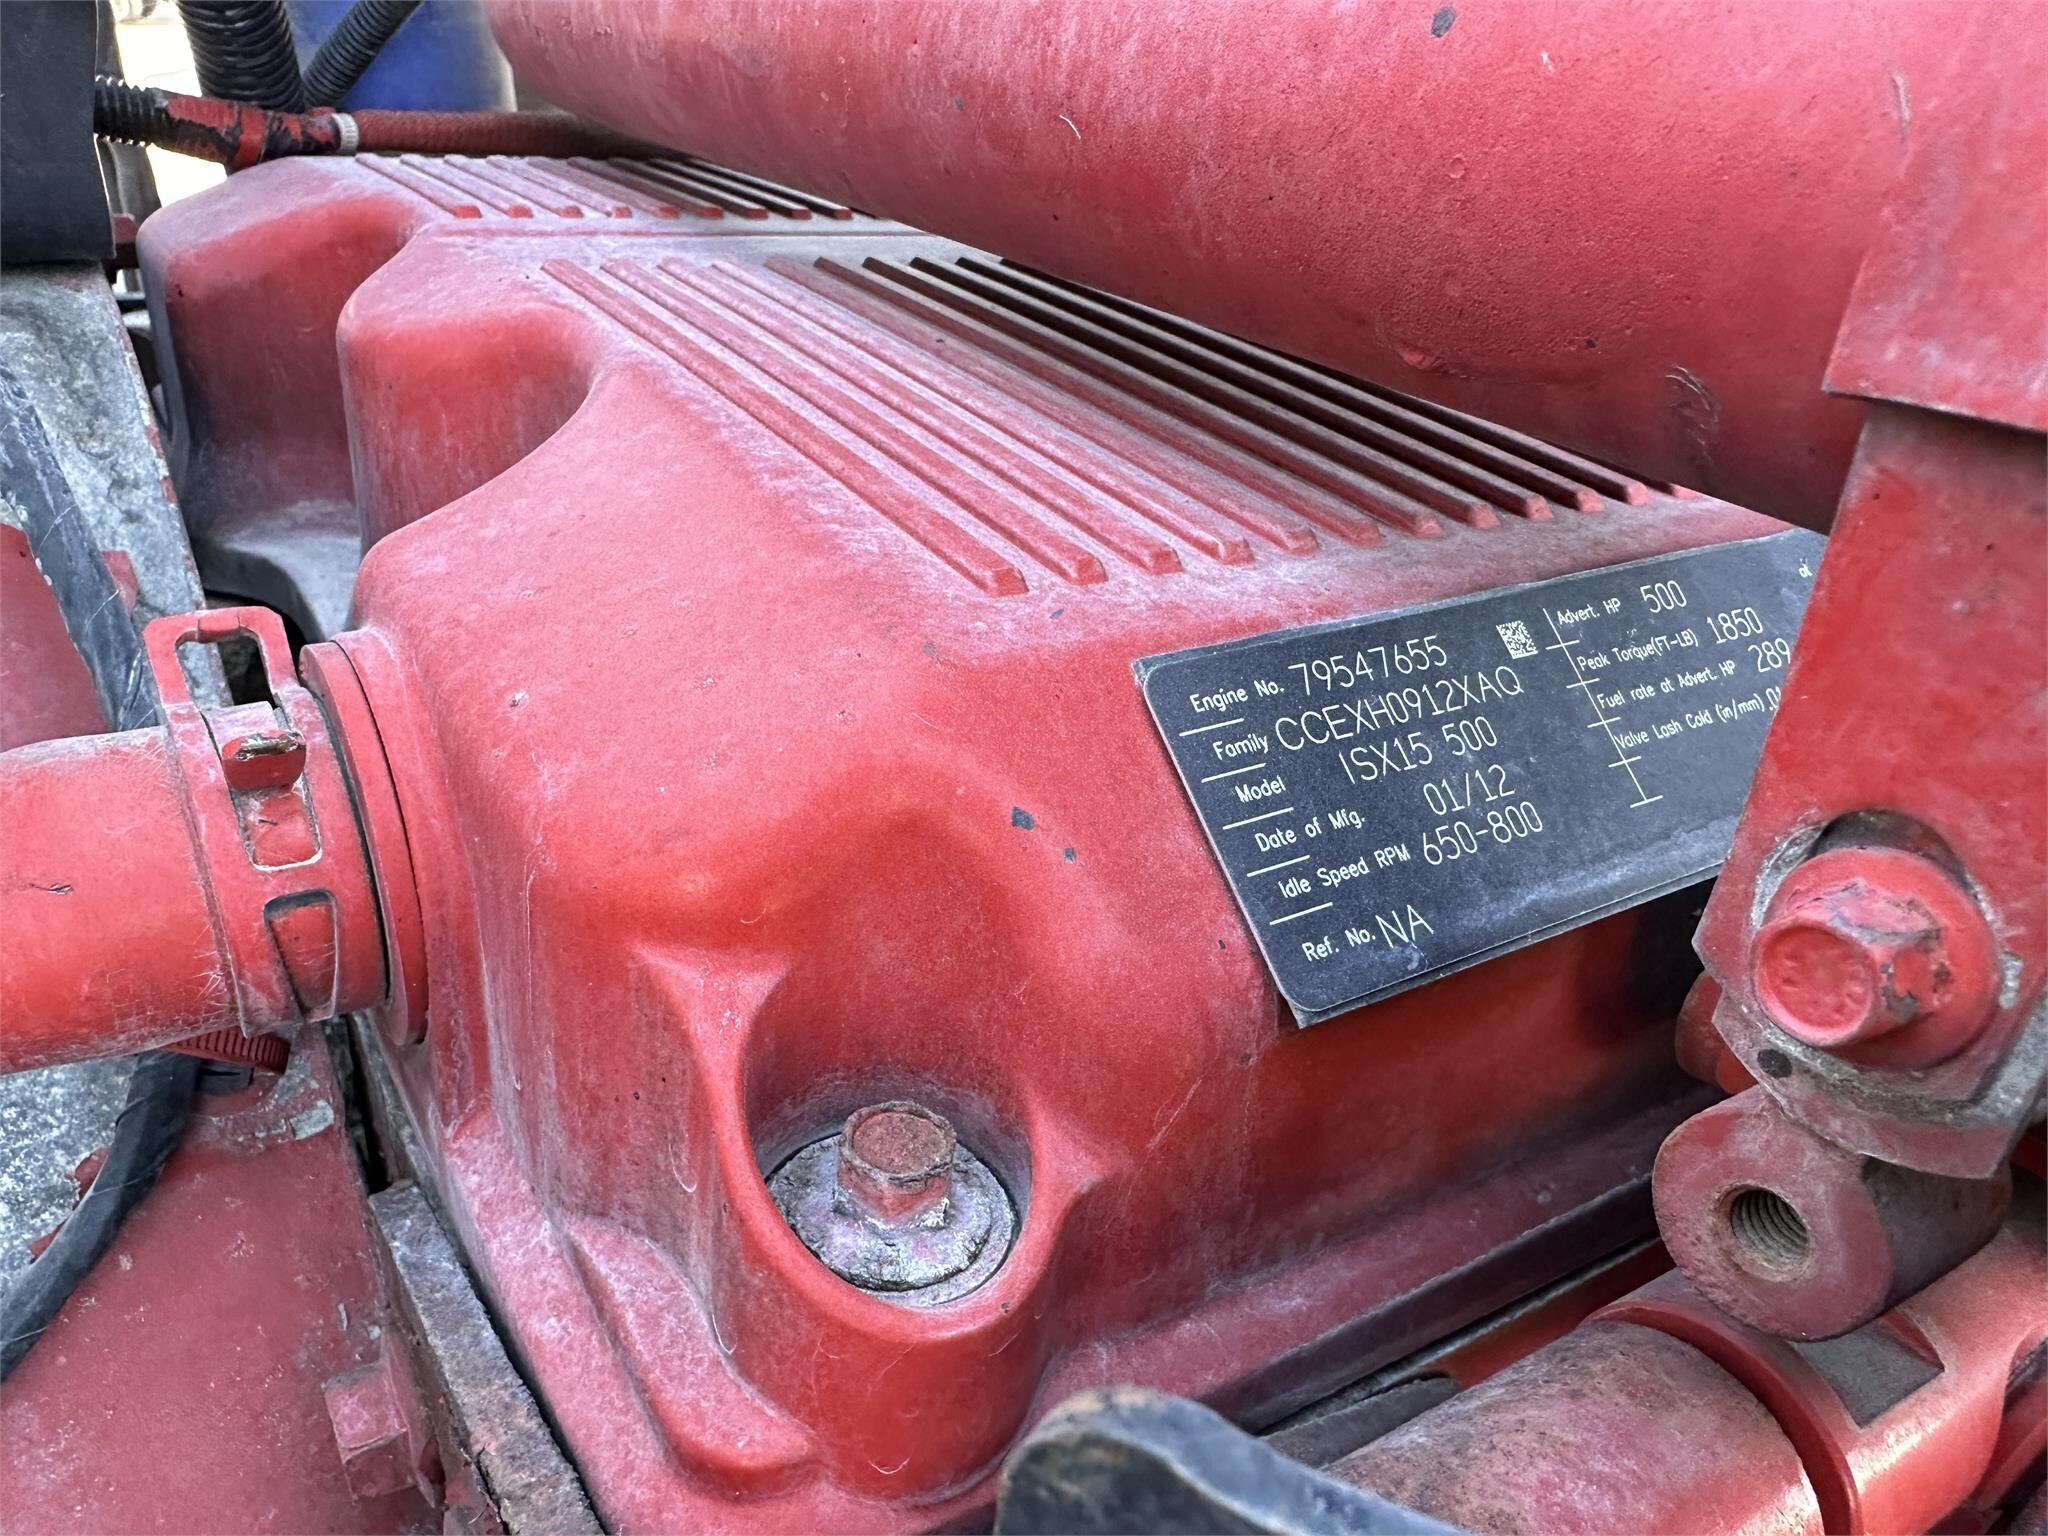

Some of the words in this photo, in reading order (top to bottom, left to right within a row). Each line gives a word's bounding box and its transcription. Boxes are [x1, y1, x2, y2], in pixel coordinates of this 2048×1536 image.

[1556, 604, 1601, 626] Advert.
[1602, 597, 1622, 614] HP
[1640, 580, 1688, 613] 500
[1576, 649, 1611, 671] Peak
[1611, 628, 1699, 662] Torque(FT-LB)
[1706, 606, 1764, 645] 1850
[1189, 685, 1249, 712] Engine
[1253, 678, 1285, 698] No.
[1288, 634, 1447, 697] 79547655
[1597, 688, 1626, 709] Fuel
[1631, 682, 1656, 701] rate
[1660, 677, 1675, 694] at
[1678, 668, 1718, 689] Advert.
[1719, 659, 1737, 676] HP
[1747, 637, 1792, 673] 289
[1212, 733, 1269, 761] Family
[1275, 665, 1525, 751] CCEXH0912XAQ
[1614, 729, 1650, 750] Valve
[1654, 719, 1683, 740] Lash
[1685, 710, 1714, 730] Cold
[1716, 692, 1766, 724] (in/mm)
[1235, 776, 1287, 804] Model
[1338, 731, 1434, 784] ISX15
[1442, 715, 1499, 757] 500
[1255, 829, 1298, 853] Date
[1304, 821, 1322, 838] of
[1331, 807, 1366, 831] Mfg.
[1423, 764, 1516, 816] 01/12
[1278, 876, 1312, 899] Idle
[1316, 856, 1369, 887] Speed
[1374, 843, 1411, 870] RPM
[1422, 801, 1544, 866] 650-800
[1301, 936, 1340, 962] Ref.
[1344, 926, 1376, 948] No.
[1375, 904, 1434, 949] NA
